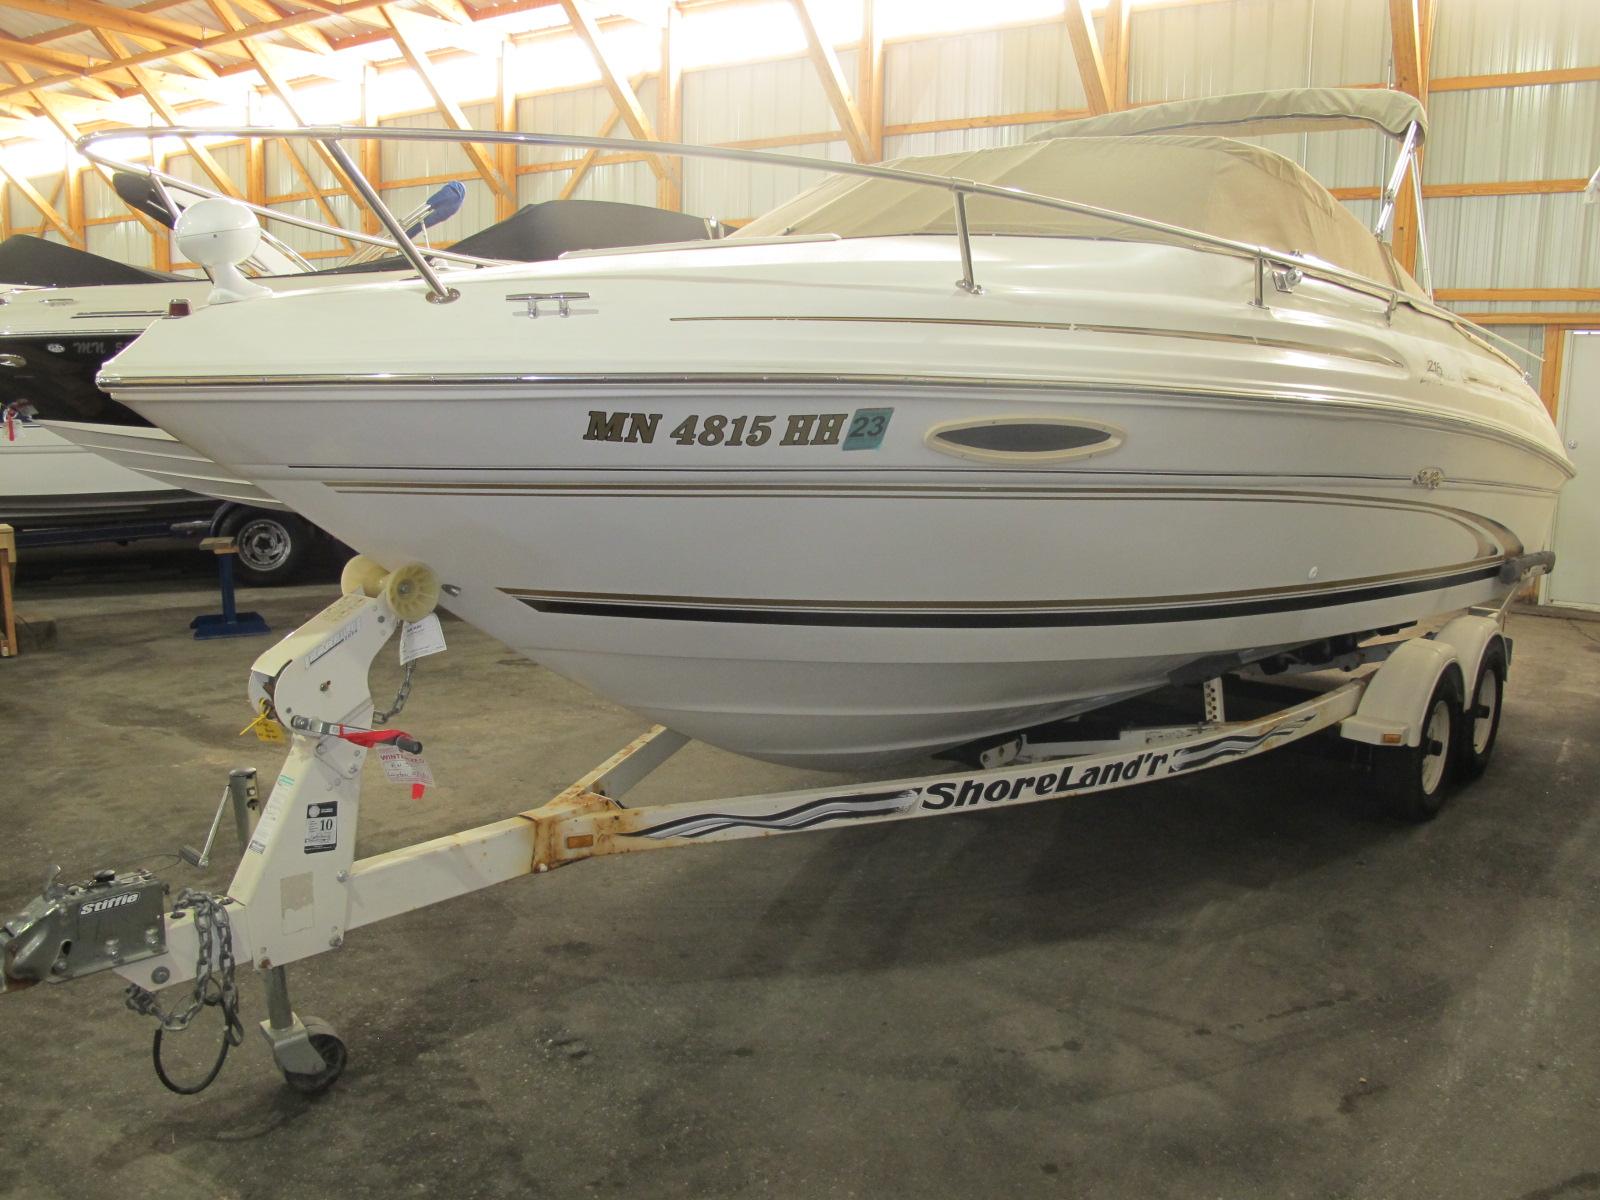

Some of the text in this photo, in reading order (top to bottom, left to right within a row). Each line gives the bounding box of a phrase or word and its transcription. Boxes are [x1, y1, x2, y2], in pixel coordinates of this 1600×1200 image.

[582, 410, 849, 447] MN 4815 HH
[849, 415, 886, 438] 23
[922, 751, 1168, 810] ShoreLand'r
[320, 818, 333, 831] 10
